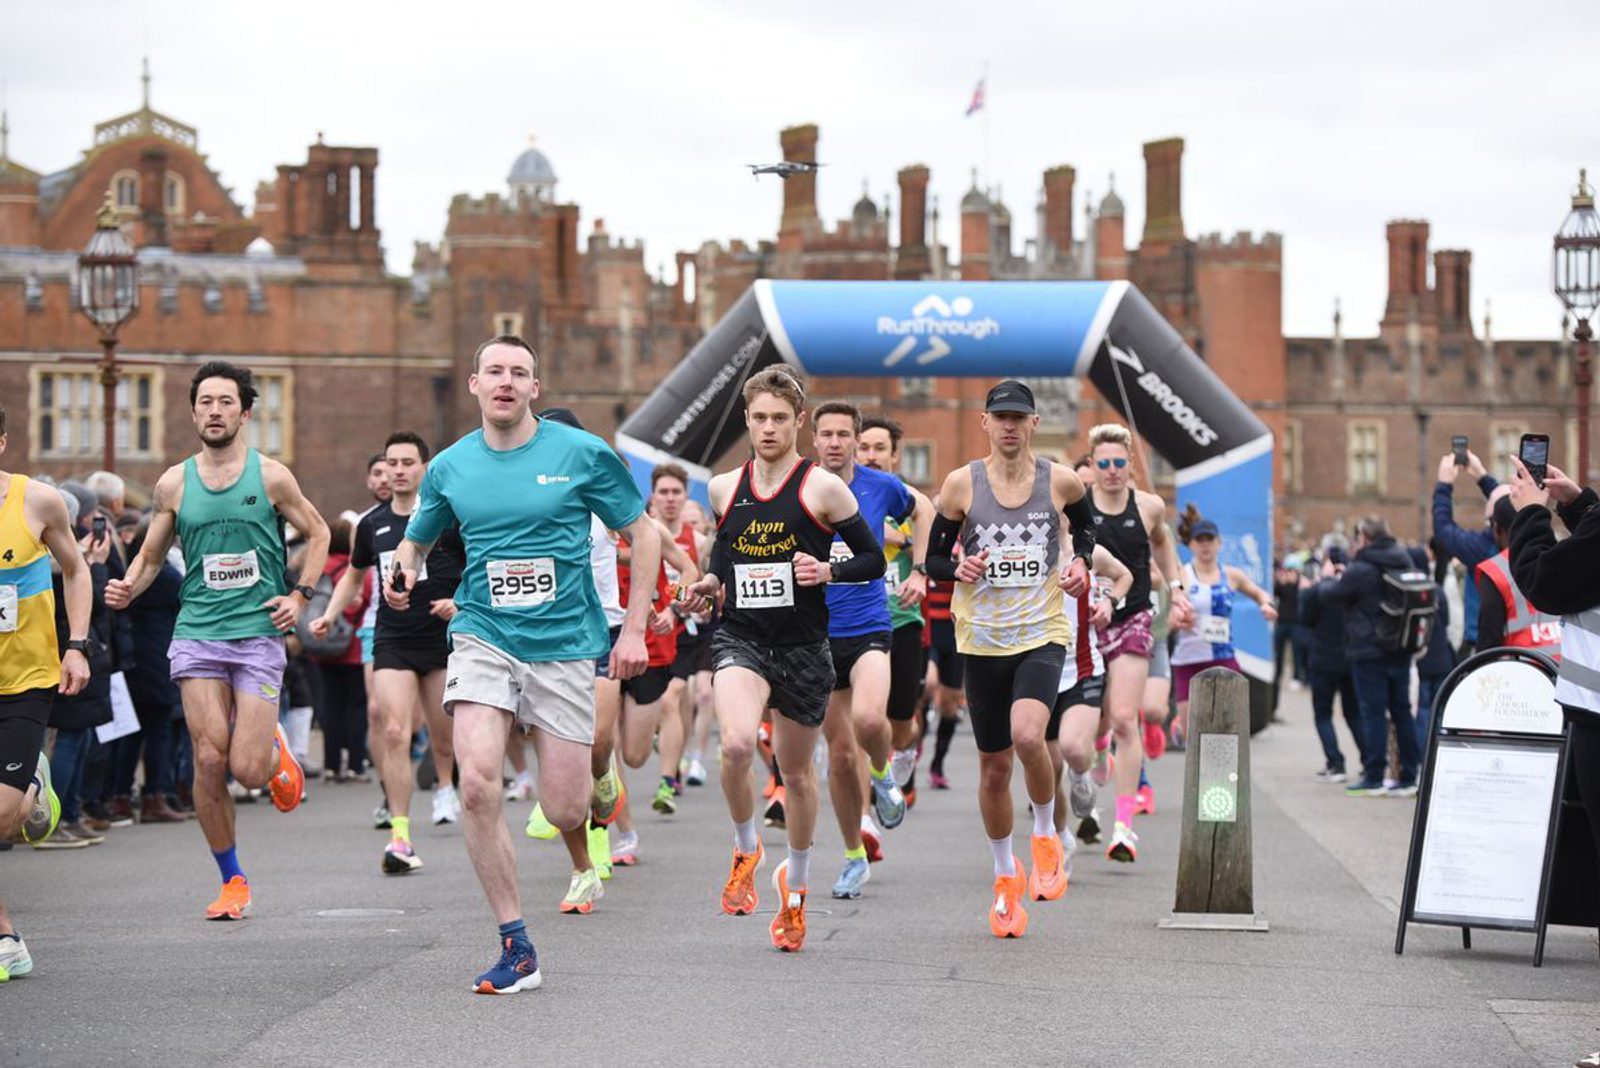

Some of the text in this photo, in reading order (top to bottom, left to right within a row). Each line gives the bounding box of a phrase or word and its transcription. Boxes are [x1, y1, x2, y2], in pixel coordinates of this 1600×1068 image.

[876, 315, 1000, 340] RunThrough
[1137, 371, 1219, 447] BROOKS
[1028, 512, 1050, 520] SOAR
[743, 518, 784, 535] Avon
[731, 533, 798, 557] Somerset
[758, 535, 768, 545] &
[208, 567, 255, 582] EDWIN
[987, 560, 1041, 579] 1949
[491, 574, 553, 597] 2959
[741, 579, 785, 599] 1113
